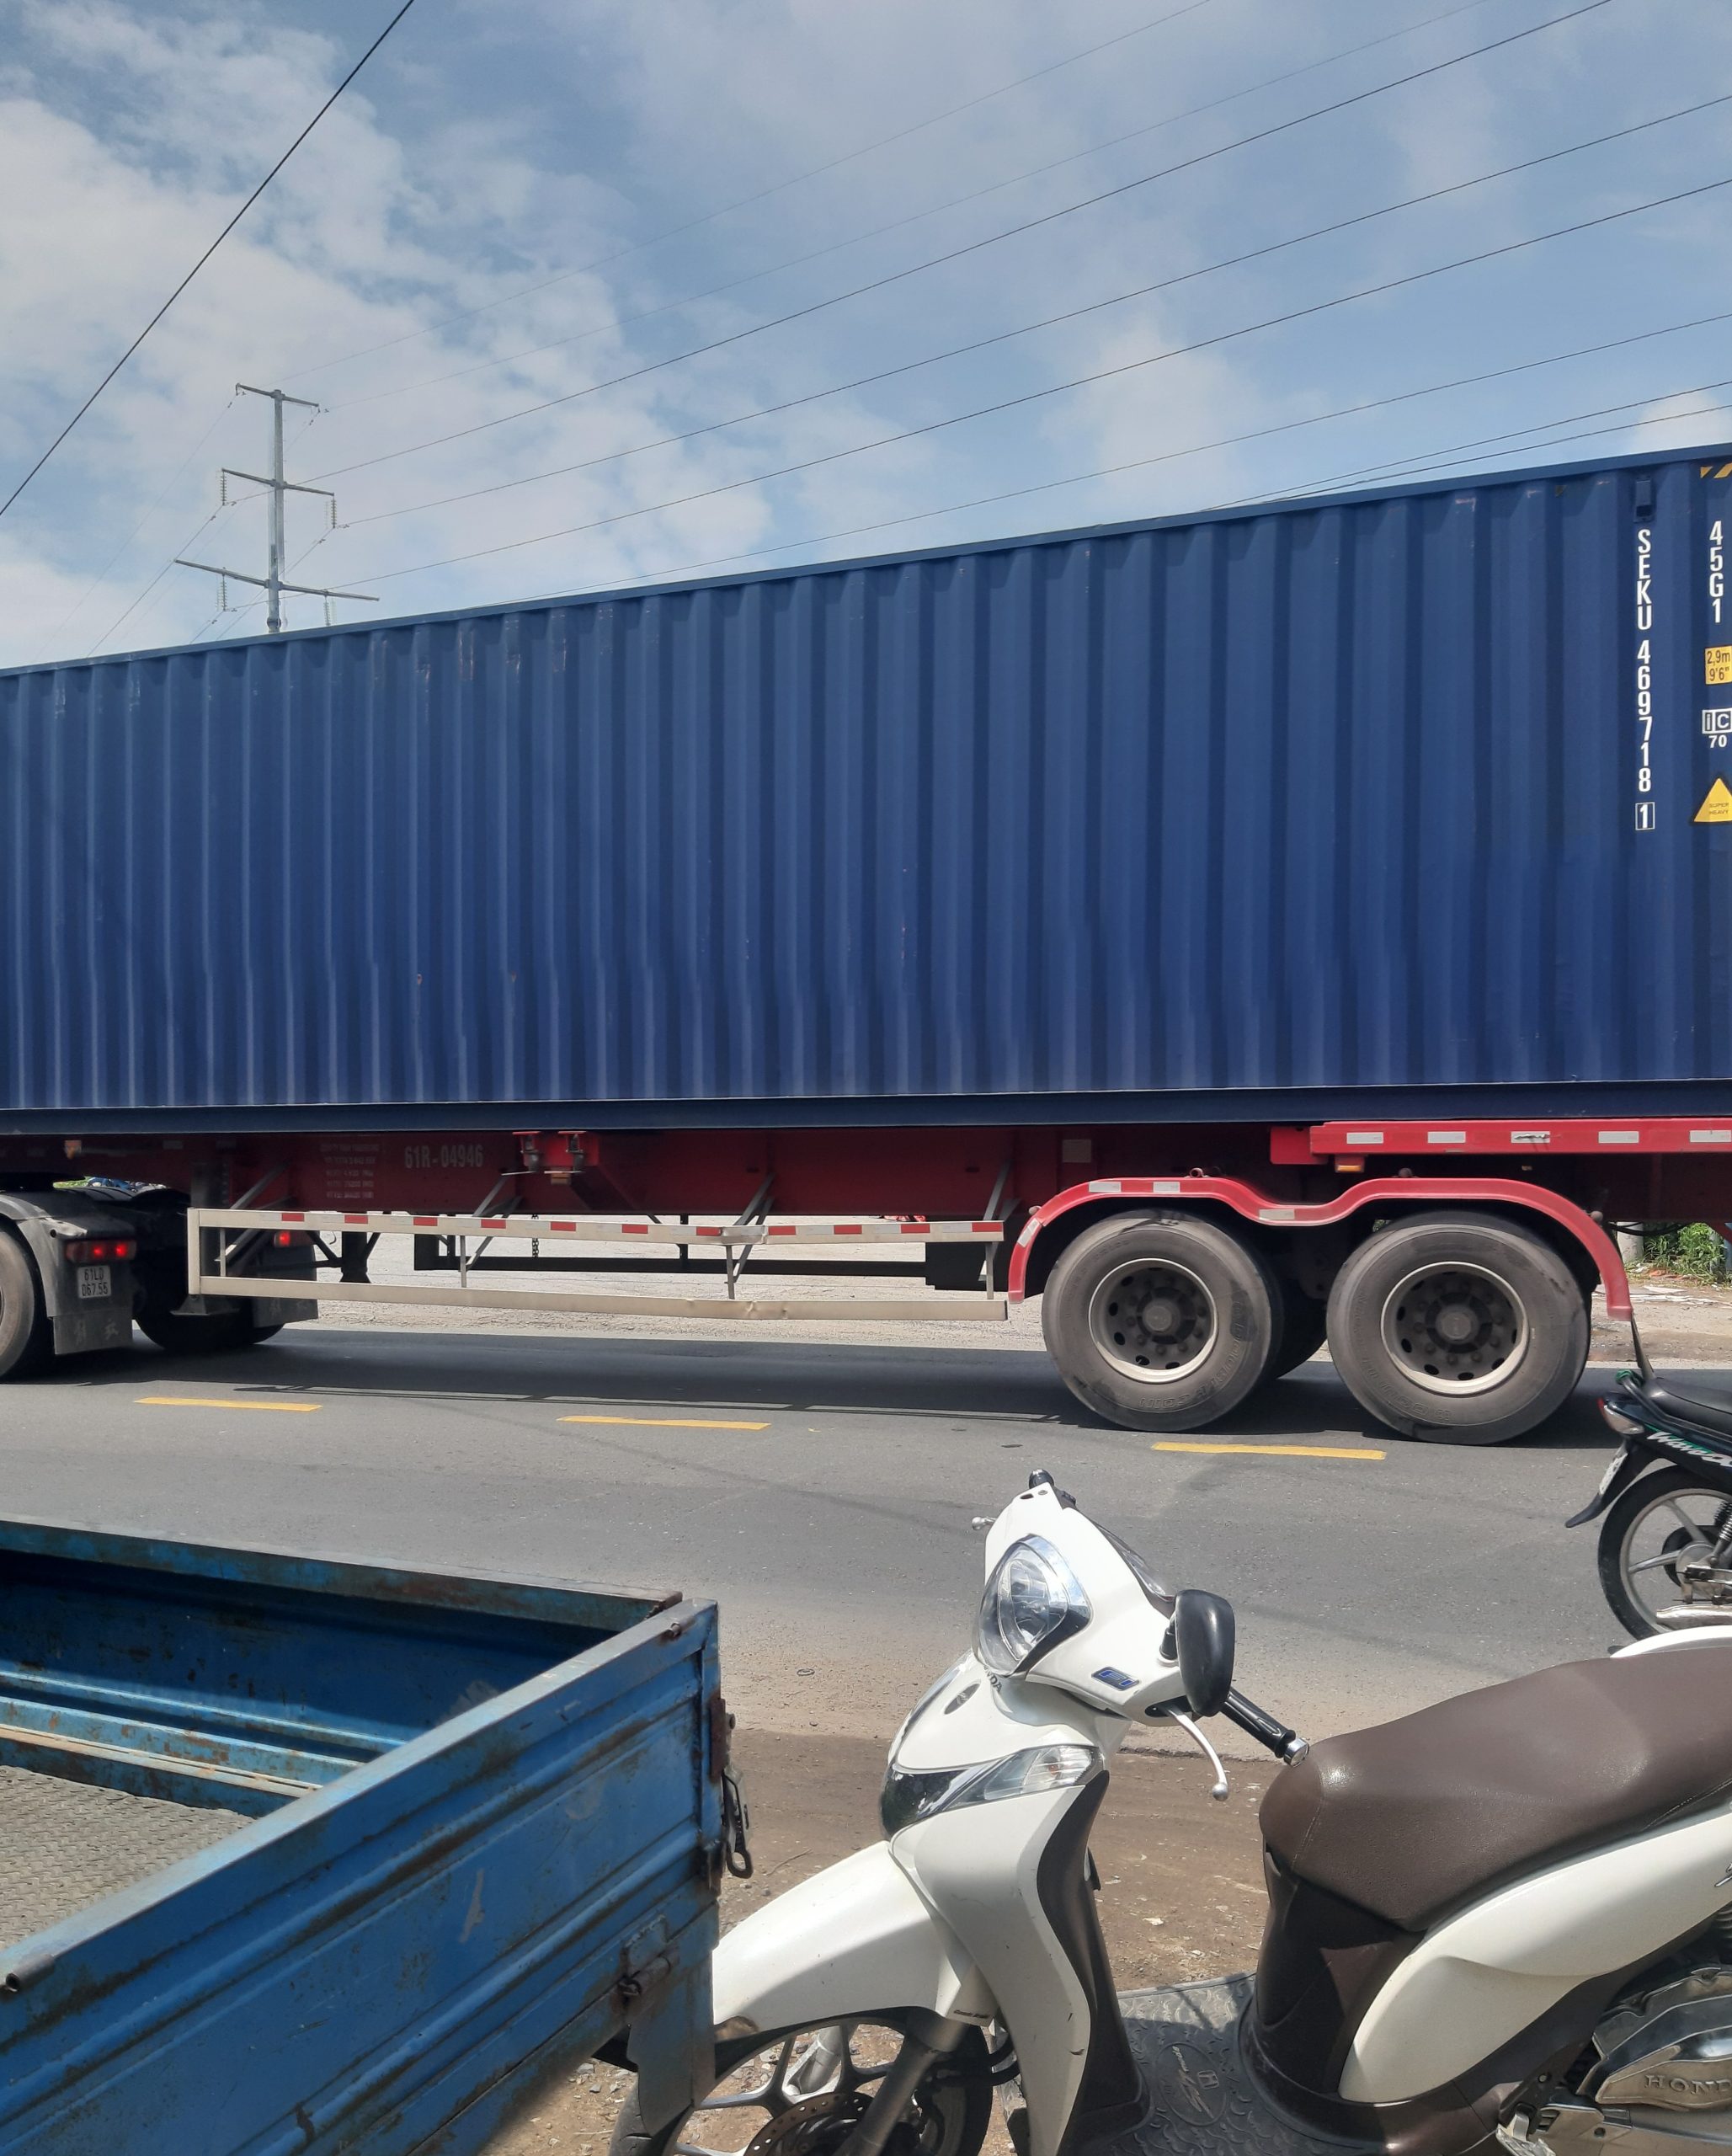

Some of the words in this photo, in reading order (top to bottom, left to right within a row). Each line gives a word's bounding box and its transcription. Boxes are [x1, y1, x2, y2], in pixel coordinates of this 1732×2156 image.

[1637, 529, 1652, 631] SEKU
[1708, 520, 1724, 624] 45G1
[1706, 650, 1731, 667] 2,9m
[1637, 639, 1653, 792] 469718
[1708, 734, 1727, 748] 70
[1639, 804, 1649, 829] 1
[983, 1665, 1003, 1692] NDA
